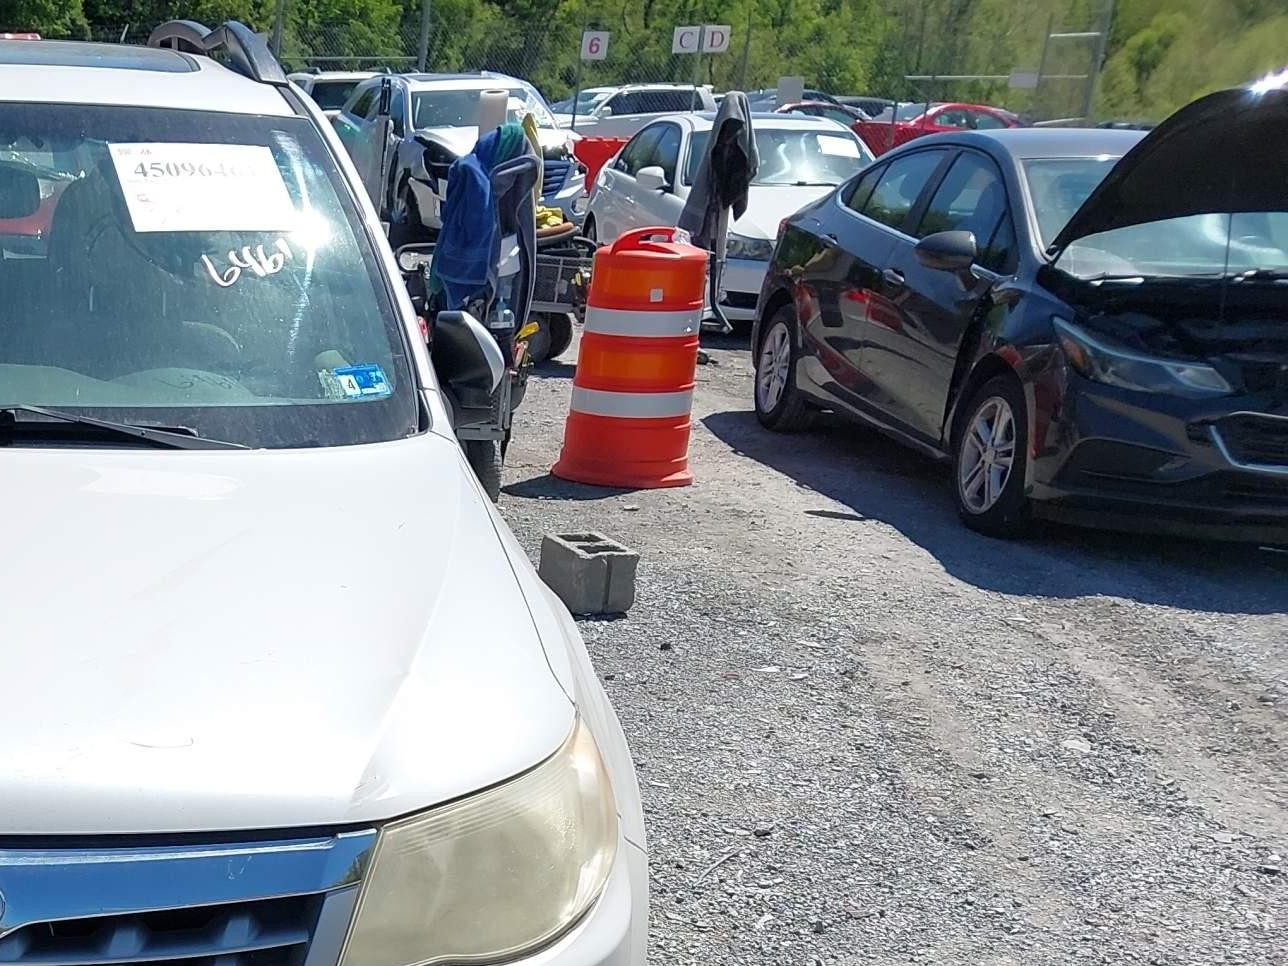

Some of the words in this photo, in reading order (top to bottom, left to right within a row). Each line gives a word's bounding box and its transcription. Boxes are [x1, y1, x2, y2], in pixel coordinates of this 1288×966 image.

[588, 37, 601, 54] 6
[679, 31, 694, 49] C
[710, 30, 725, 48] D
[201, 238, 293, 288] 6461
[345, 378, 356, 391] 4
